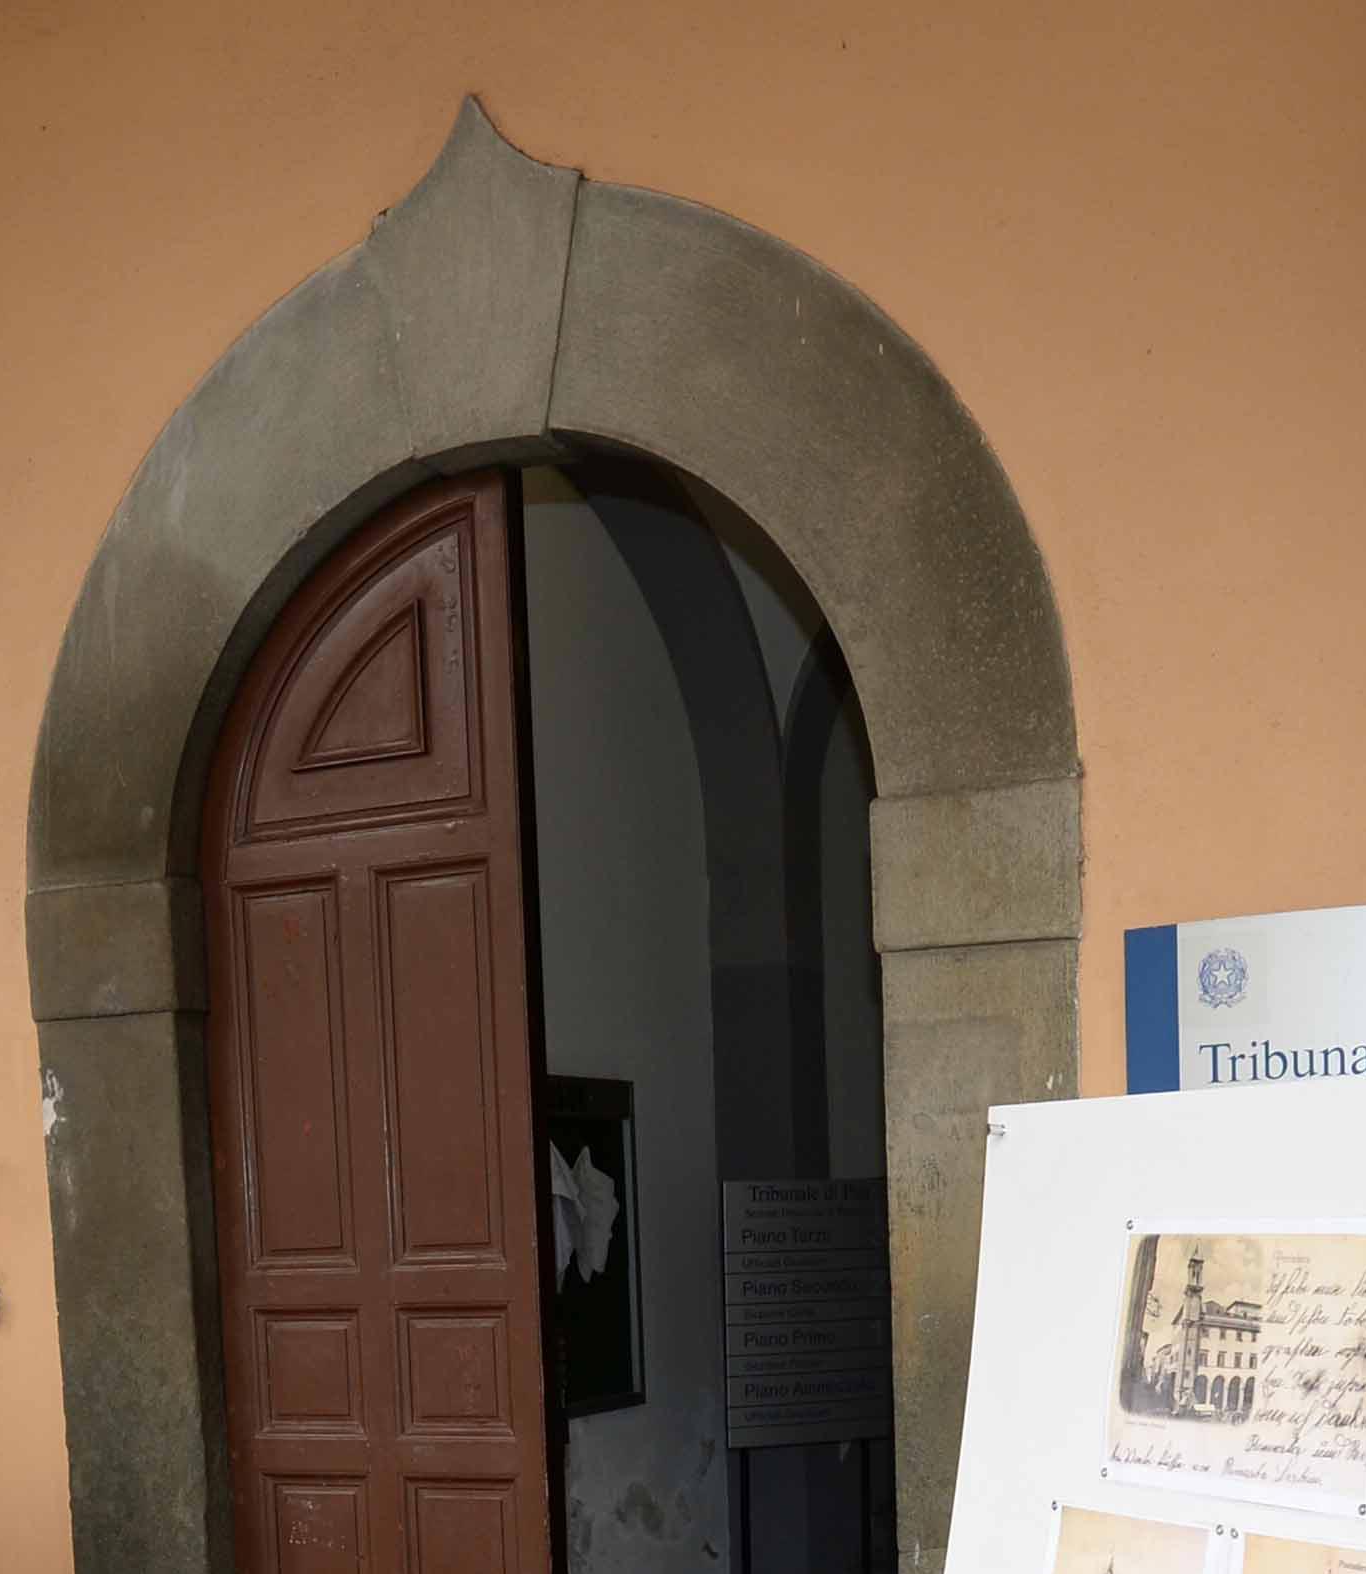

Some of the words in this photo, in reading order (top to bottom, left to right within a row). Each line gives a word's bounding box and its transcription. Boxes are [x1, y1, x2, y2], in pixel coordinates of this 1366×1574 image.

[741, 1230, 787, 1247] Piano
[743, 1281, 788, 1298] Piano
[744, 1331, 789, 1349] Piano
[745, 1382, 790, 1400] Piano
